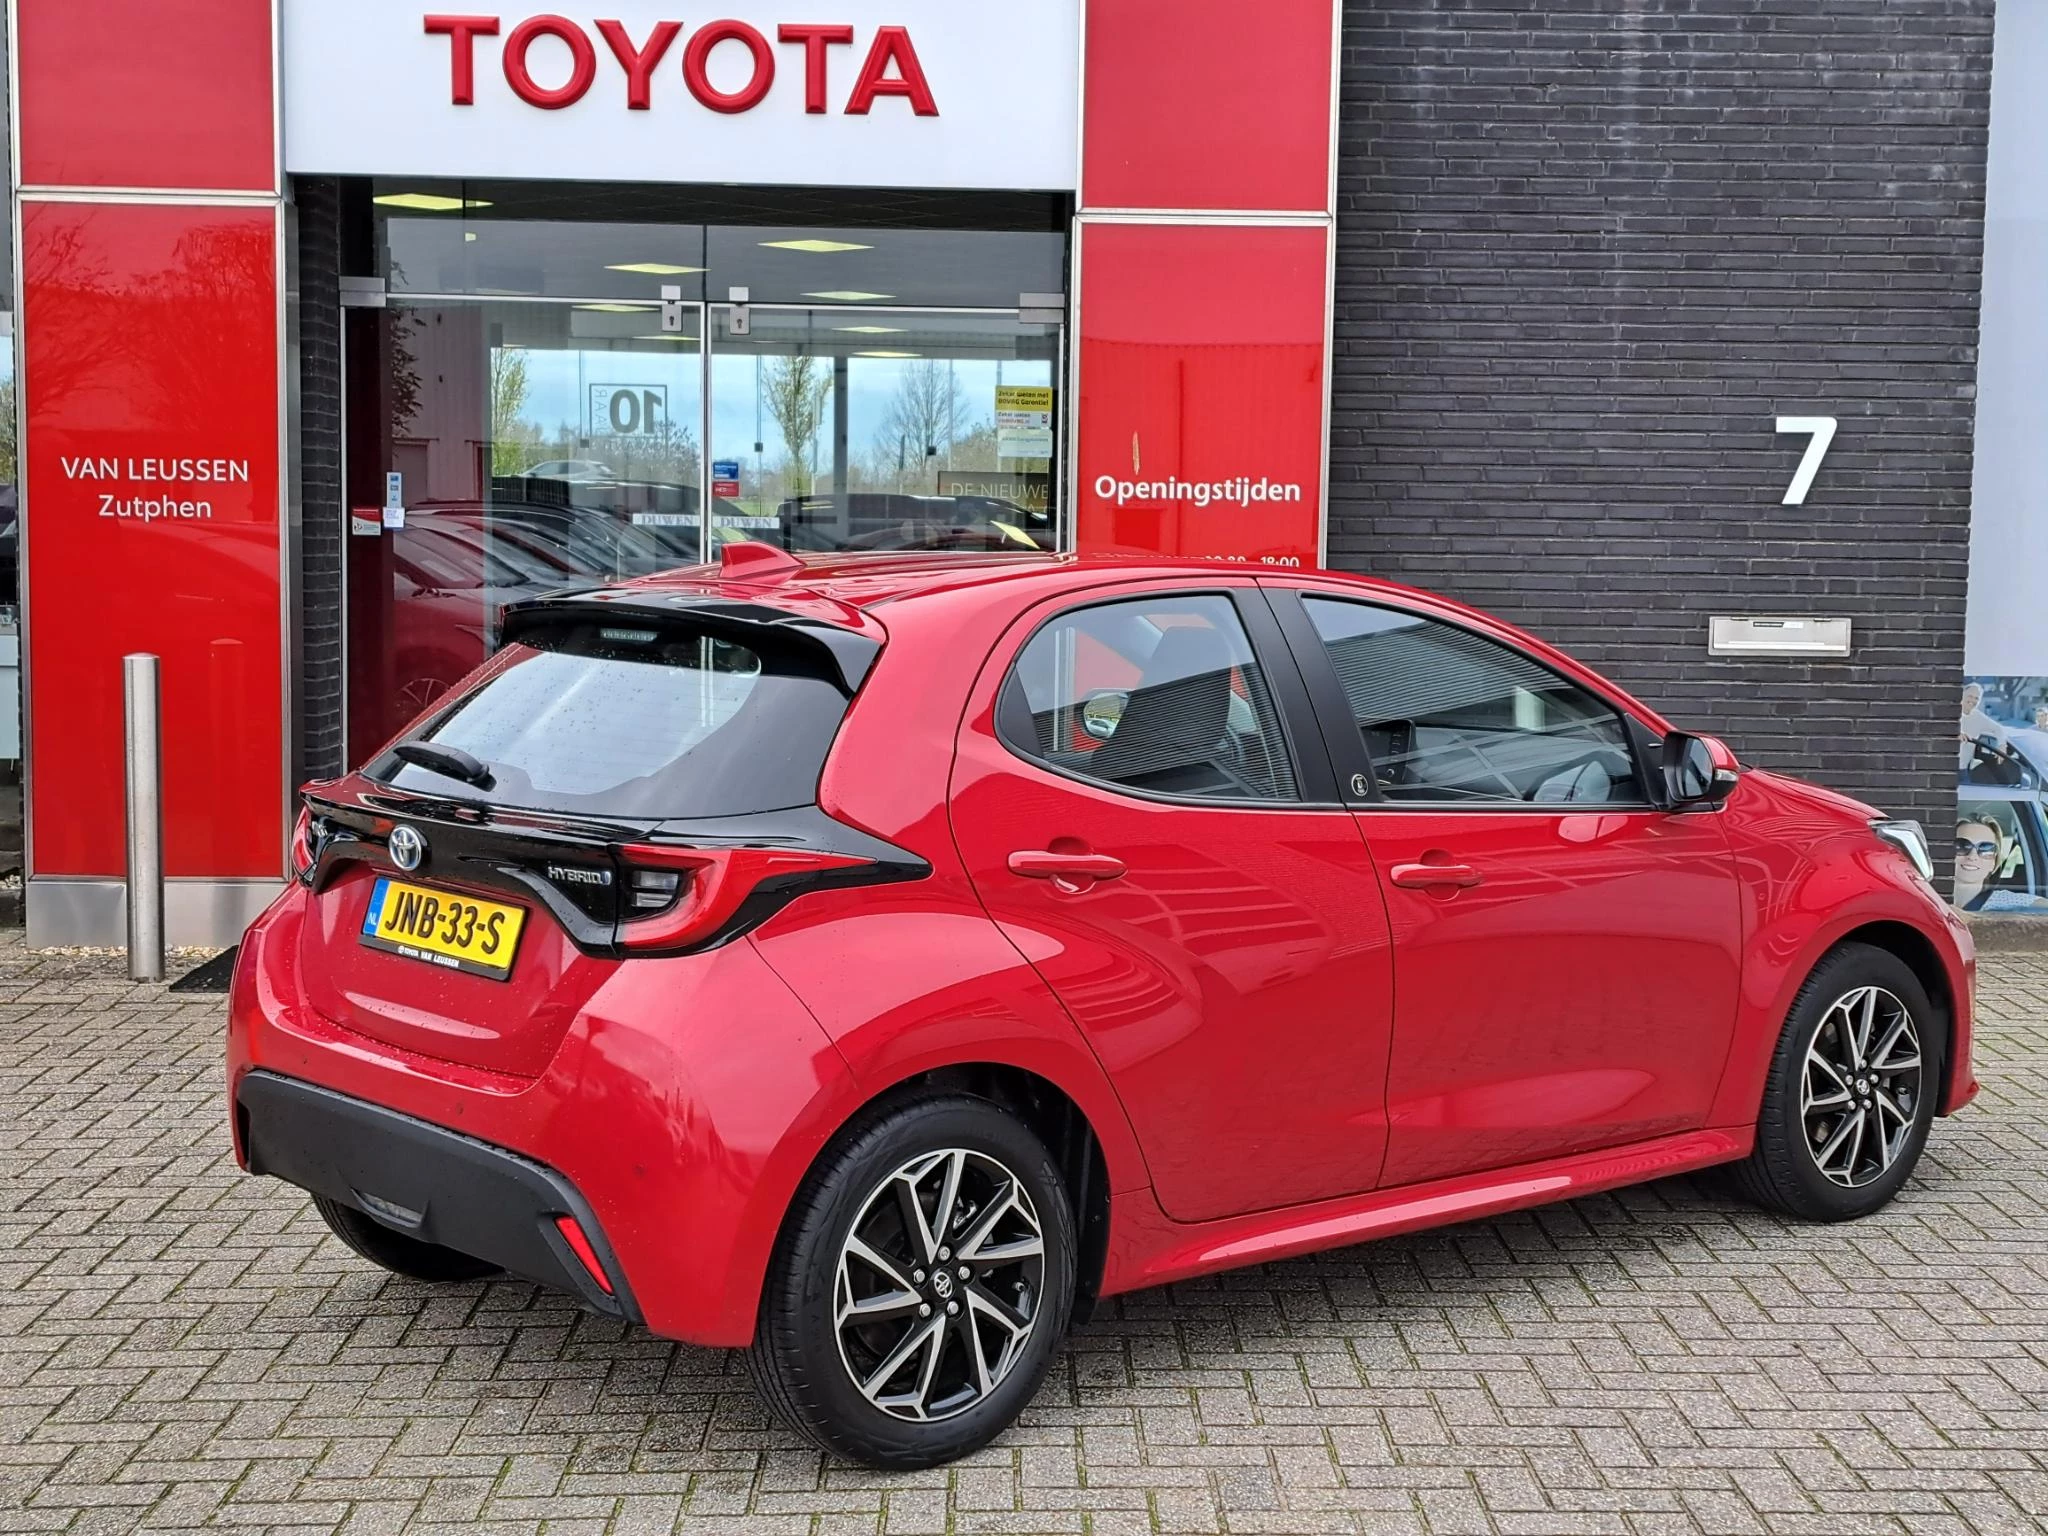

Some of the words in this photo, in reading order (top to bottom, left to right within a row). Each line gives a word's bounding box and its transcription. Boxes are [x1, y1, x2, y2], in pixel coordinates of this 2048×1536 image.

[424, 14, 940, 117] TOYOTA
[61, 457, 119, 480] VAN
[128, 458, 249, 482] LEUSSEN
[1775, 416, 1838, 505] 7
[951, 482, 976, 497] DE
[980, 482, 1048, 500] NIEUWE
[1095, 475, 1302, 508] Openingstijden
[98, 494, 213, 523] Zutphen
[641, 514, 694, 526] DUWEN
[720, 516, 773, 528] DUWEN
[548, 866, 603, 885] HYBRID
[367, 913, 378, 926] NL
[384, 890, 506, 956] JNB-33-S
[420, 950, 433, 961] VAN
